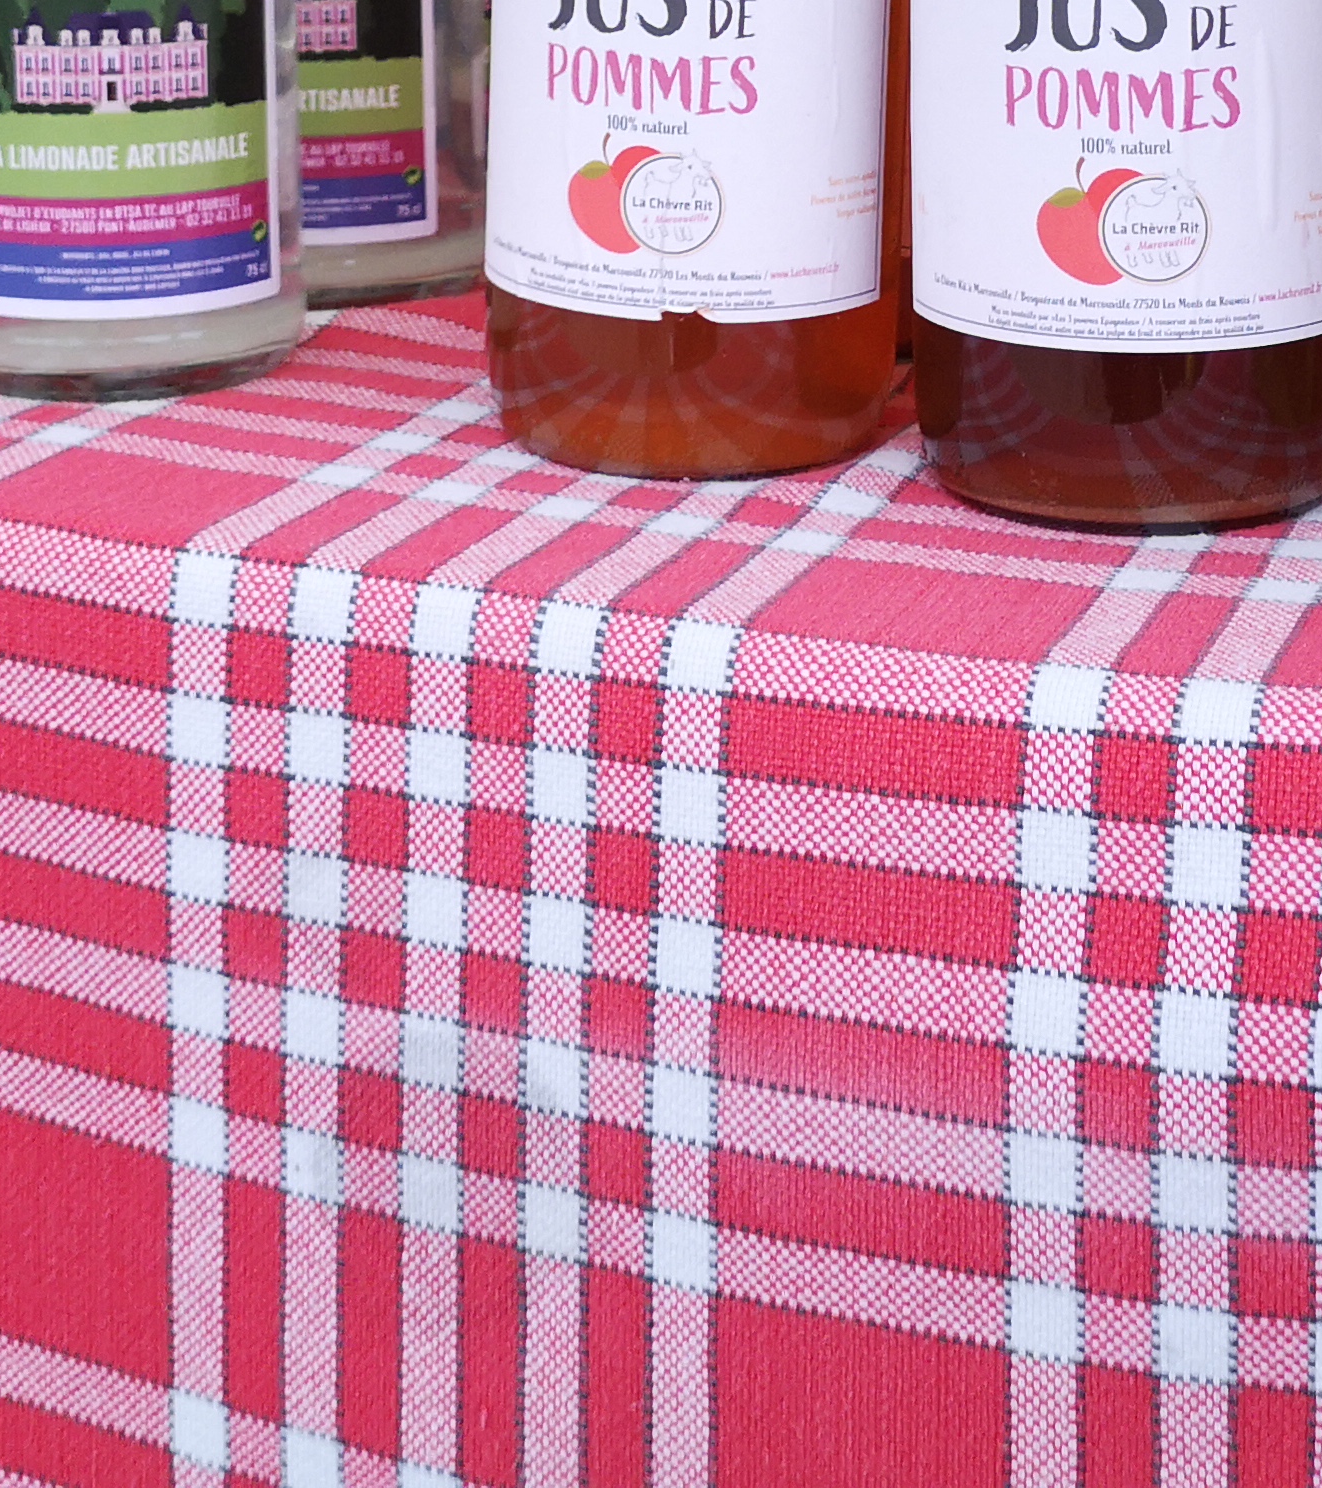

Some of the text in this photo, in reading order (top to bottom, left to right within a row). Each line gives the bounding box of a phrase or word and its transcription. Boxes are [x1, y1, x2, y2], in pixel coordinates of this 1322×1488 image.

[1190, 4, 1238, 51] DE
[546, 42, 759, 116] POMMES
[298, 83, 402, 112] RTISANALE
[1004, 64, 1241, 135] POMMES
[606, 114, 690, 135] 100% naturel
[7, 143, 120, 172] LIMONADE
[125, 131, 251, 170] ARTISANALE
[1080, 137, 1172, 155] 100% naturel
[632, 196, 713, 212] La Chèvre Rit
[1112, 221, 1199, 235] La Chèvre Rit
[1067, 296, 1078, 307] de
[1079, 296, 1131, 310] Marcouville
[1133, 298, 1160, 310] 27520
[1162, 298, 1176, 309] Les
[1178, 297, 1204, 309] Monts
[1205, 296, 1218, 308] du
